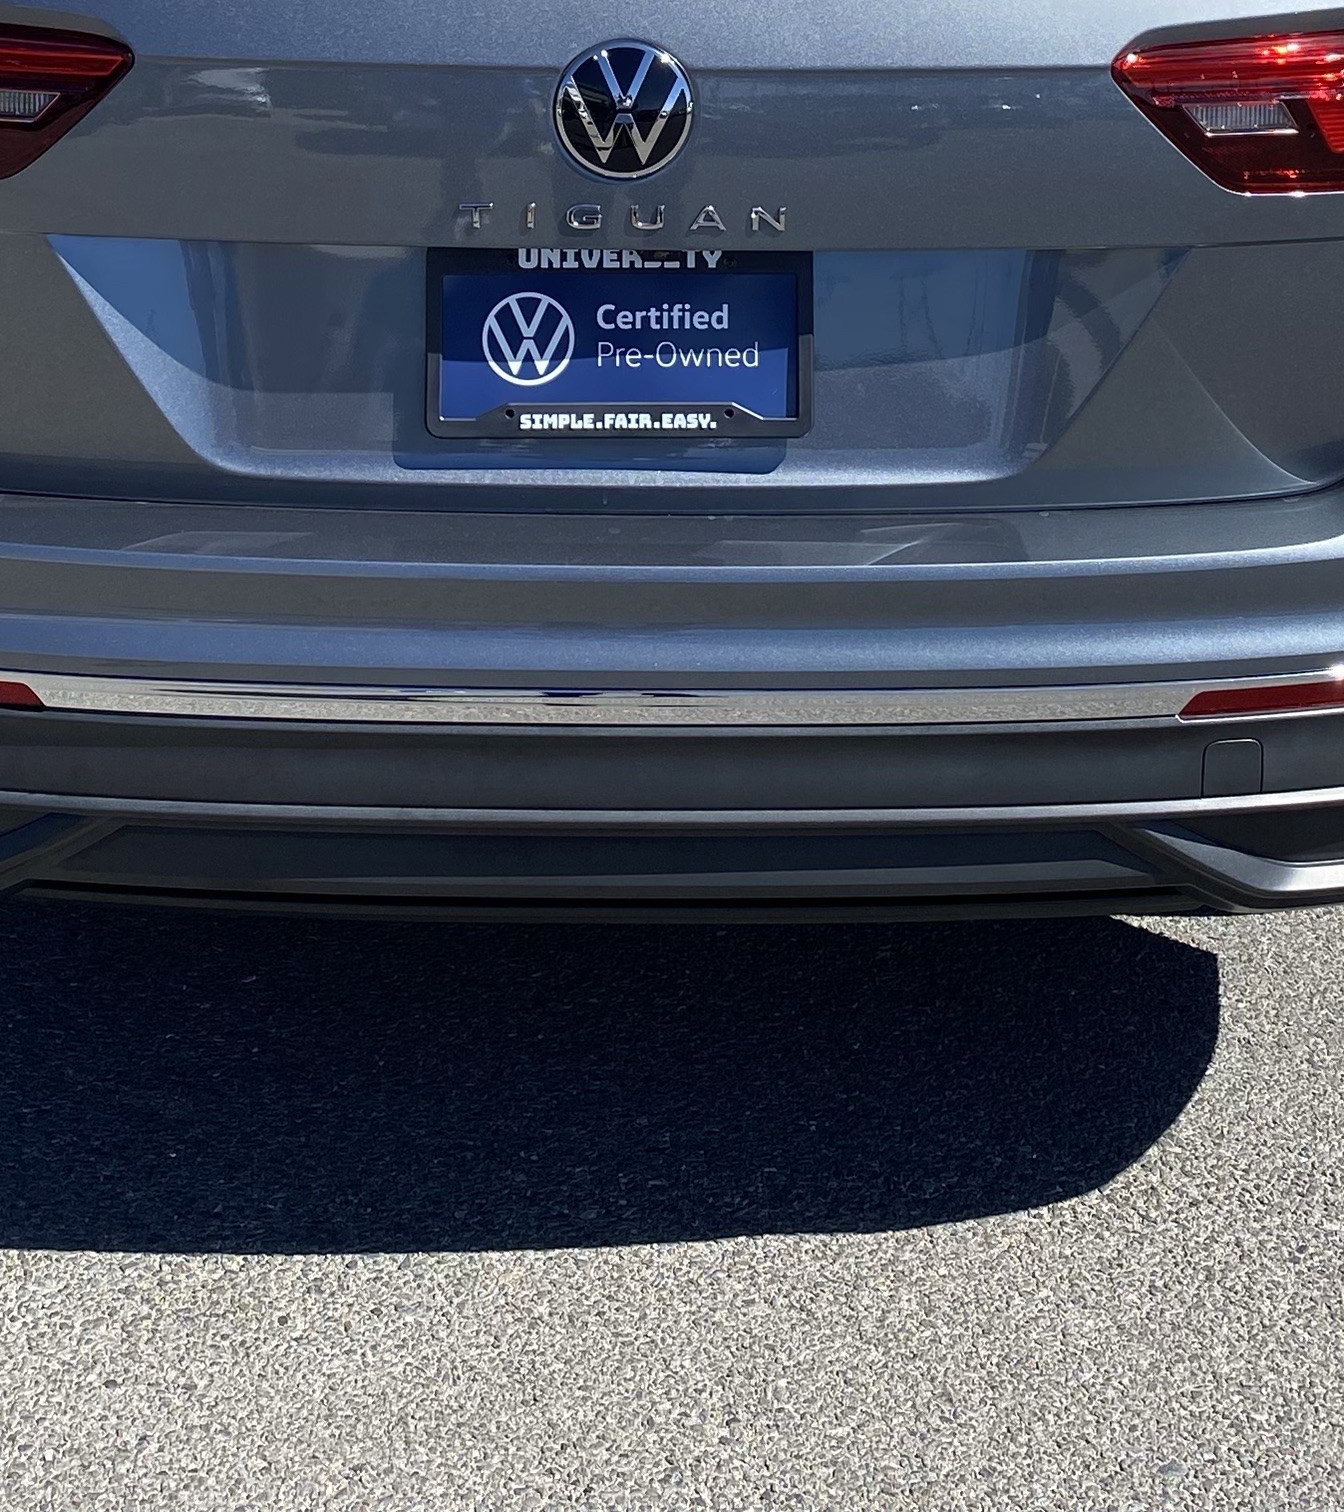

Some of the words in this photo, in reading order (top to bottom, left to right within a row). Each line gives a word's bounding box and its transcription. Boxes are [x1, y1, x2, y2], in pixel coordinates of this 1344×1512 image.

[459, 202, 788, 232] TIGUAN
[517, 247, 723, 269] UNIVERTY
[596, 303, 729, 330] Certified
[596, 341, 759, 368] Pre-Owned
